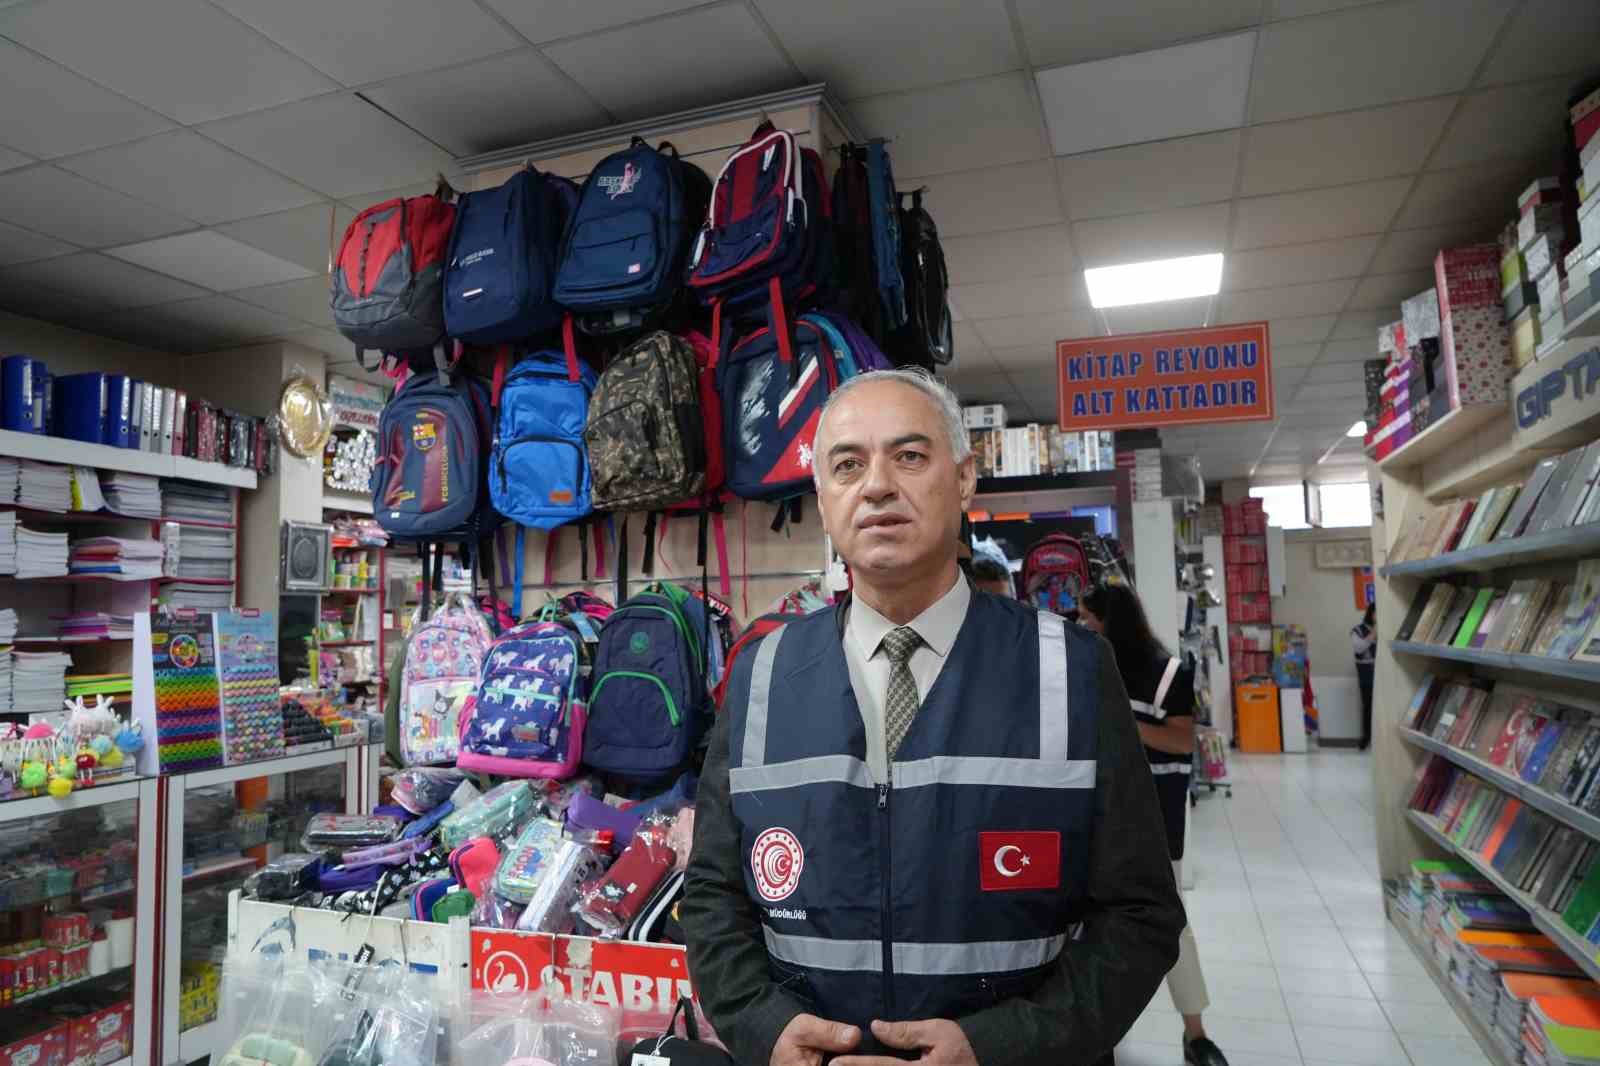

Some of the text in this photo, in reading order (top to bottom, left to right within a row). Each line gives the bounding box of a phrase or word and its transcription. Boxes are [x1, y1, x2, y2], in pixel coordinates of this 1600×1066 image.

[1068, 342, 1258, 381] KİTAP REYONU
[1072, 380, 1257, 417] ALT KATTADIR
